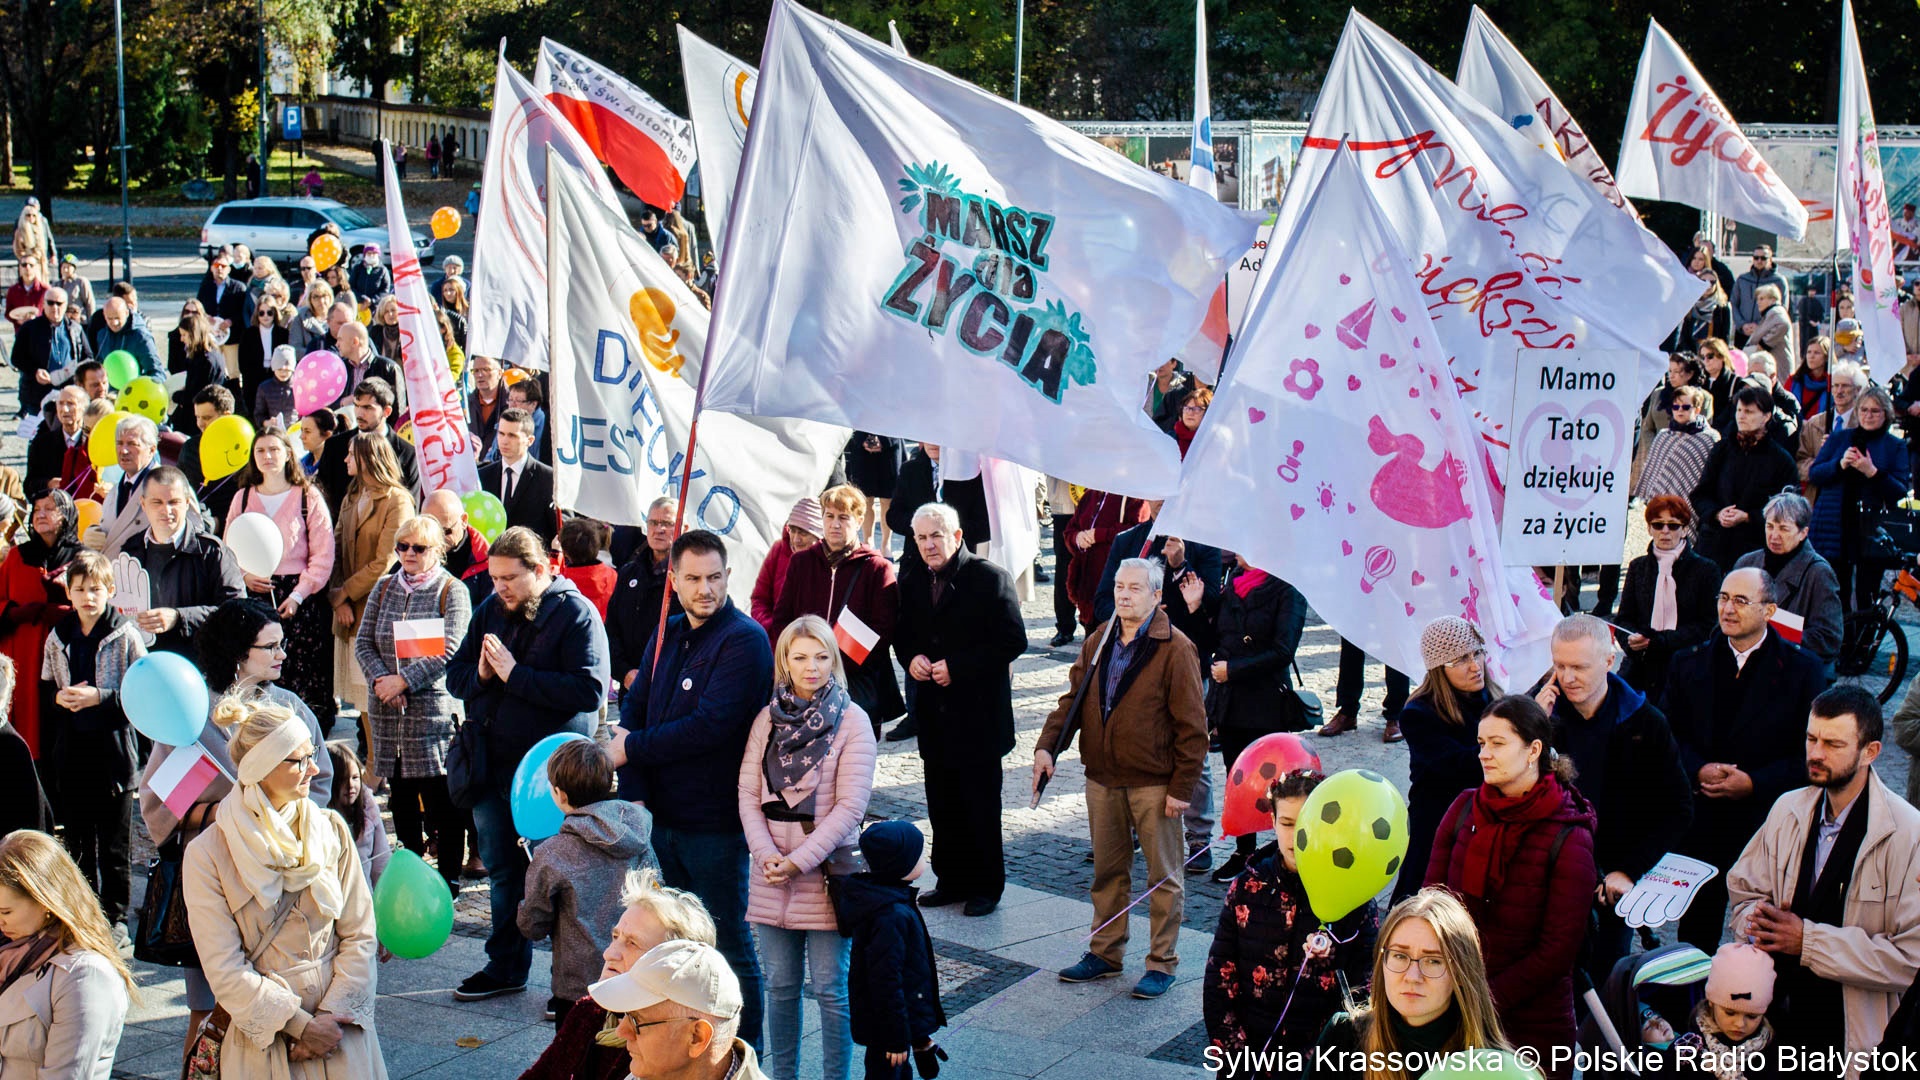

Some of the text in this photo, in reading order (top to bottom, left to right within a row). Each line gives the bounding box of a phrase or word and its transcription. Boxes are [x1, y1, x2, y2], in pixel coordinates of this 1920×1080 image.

[287, 109, 298, 131] P
[925, 190, 1053, 269] MARSZ
[975, 252, 1034, 299] dla
[884, 234, 1073, 402] ŻYCIA
[1539, 365, 1616, 391] Mamo
[1547, 416, 1600, 441] Tato
[1523, 465, 1615, 494] dziękuję
[1522, 511, 1607, 540] za życie
